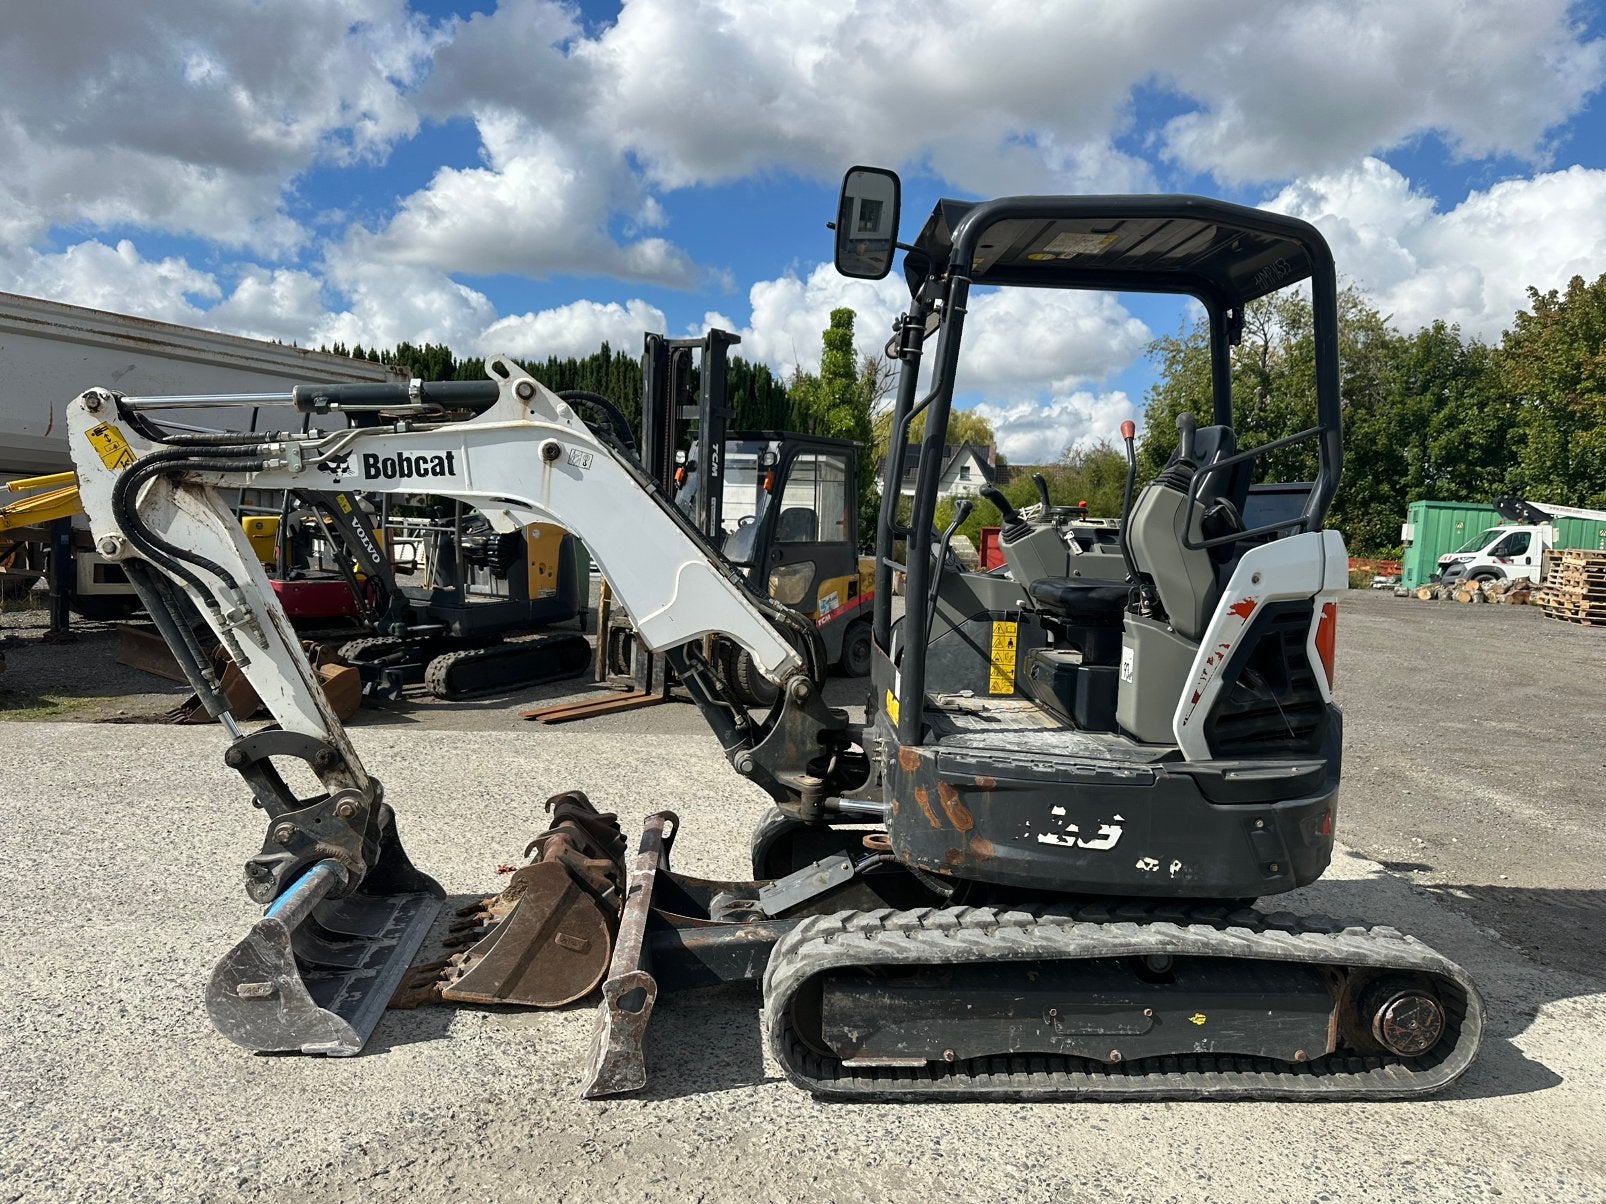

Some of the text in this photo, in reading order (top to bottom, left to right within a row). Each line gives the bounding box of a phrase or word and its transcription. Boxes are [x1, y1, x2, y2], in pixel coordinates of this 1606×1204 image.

[362, 450, 456, 480] Bobcat
[711, 443, 719, 477] TCM
[351, 516, 380, 563] VOLVO
[817, 614, 832, 627] TCM
